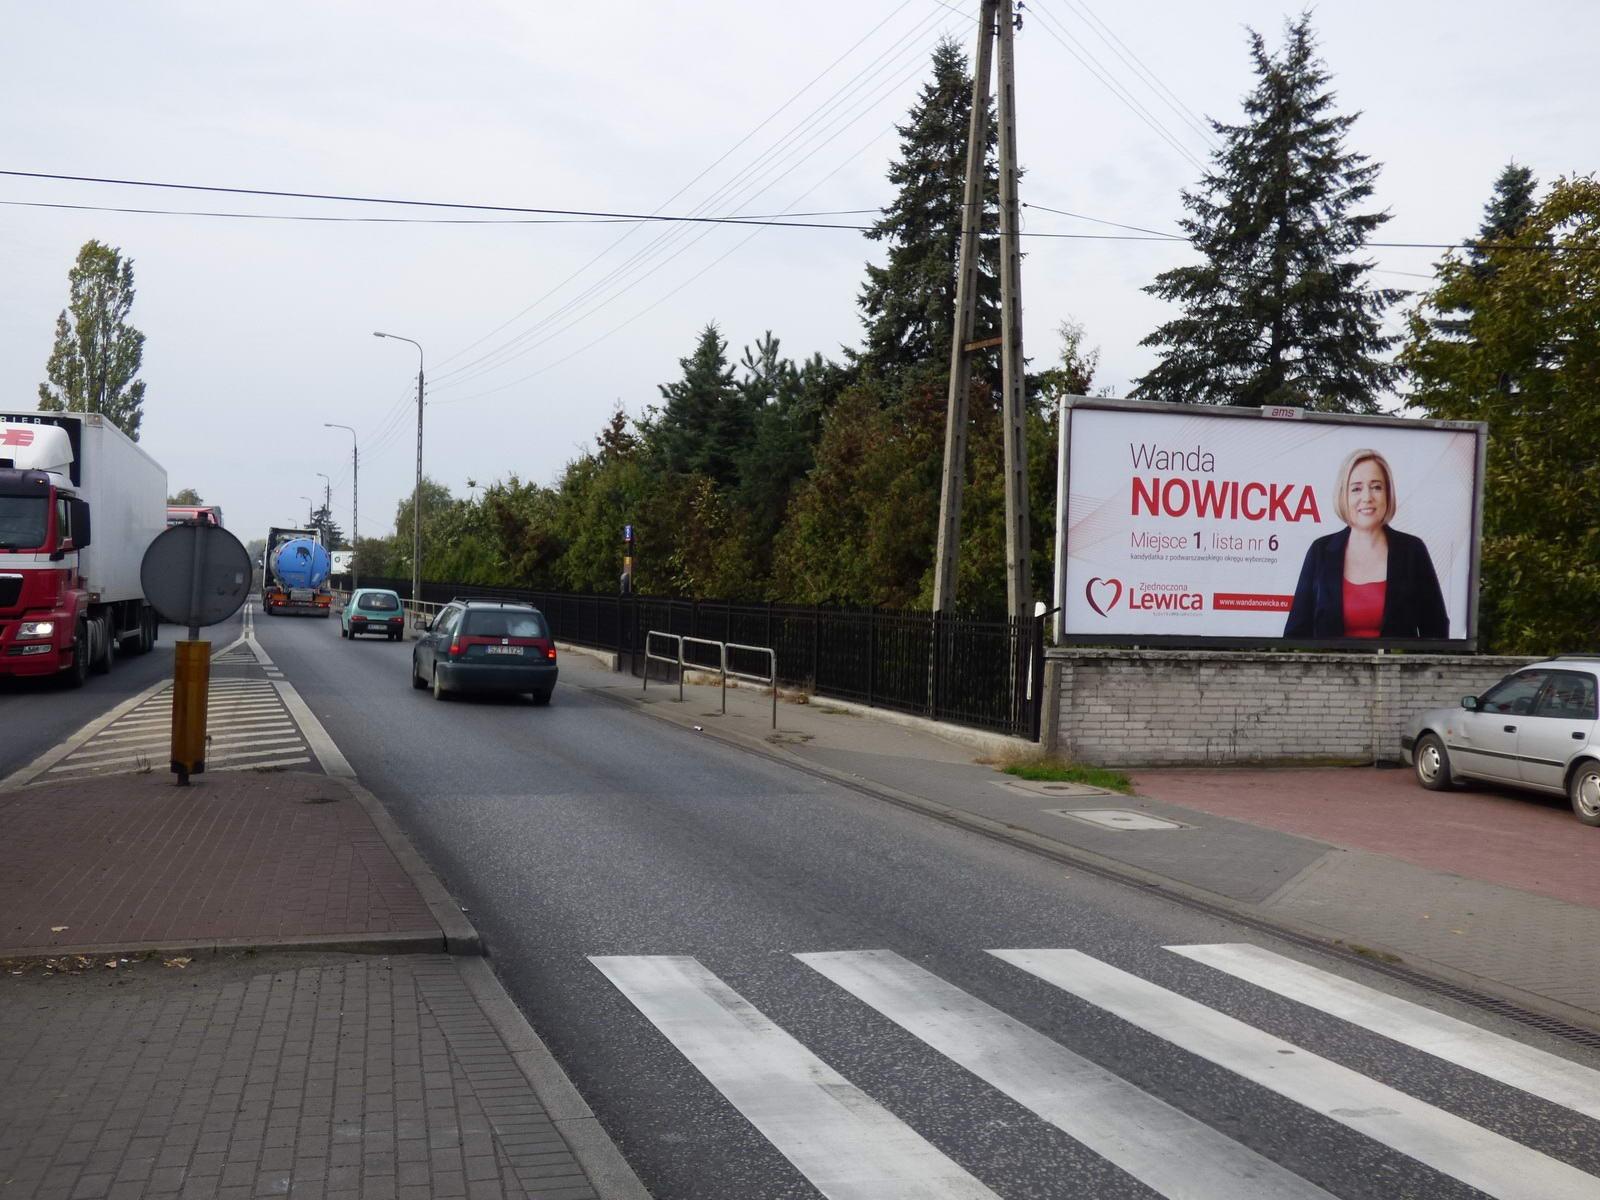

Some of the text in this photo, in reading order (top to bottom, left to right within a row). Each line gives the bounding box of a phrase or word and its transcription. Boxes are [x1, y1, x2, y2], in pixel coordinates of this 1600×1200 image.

[1271, 407, 1295, 417] ams
[1130, 442, 1215, 472] Wanda
[1131, 476, 1321, 523] NOWICKA
[1131, 531, 1279, 552] Miejsce 1, lista nr 6
[1130, 553, 1164, 562] kandydatka
[1169, 554, 1223, 563] podwarszawskiego
[1224, 555, 1243, 563] okręgu
[1244, 555, 1278, 564] wyborczego
[1139, 582, 1188, 593] Zjednoczona
[1129, 587, 1203, 611] Lewica
[1219, 598, 1289, 608] www.wandanowicka.eu
